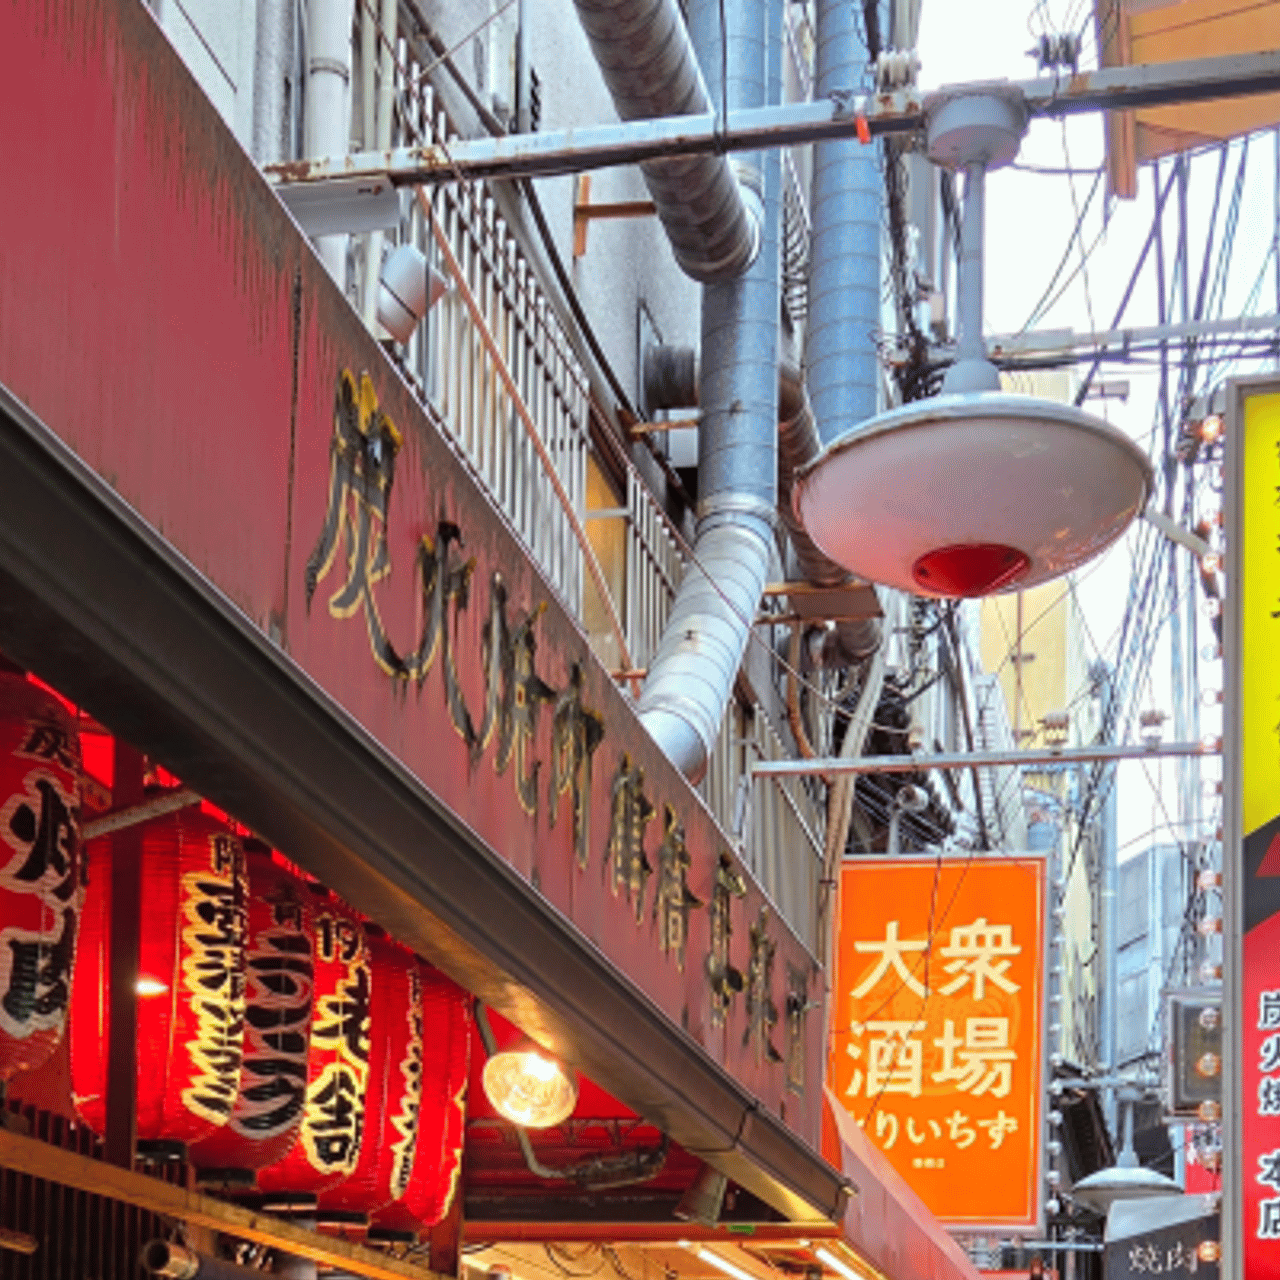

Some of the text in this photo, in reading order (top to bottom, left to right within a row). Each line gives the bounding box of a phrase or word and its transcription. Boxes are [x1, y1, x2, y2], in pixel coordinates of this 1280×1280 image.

[850, 917, 1022, 1000] 大衆
[846, 1017, 1017, 1098] 酒場
[1128, 1242, 1198, 1274] 焼肉
